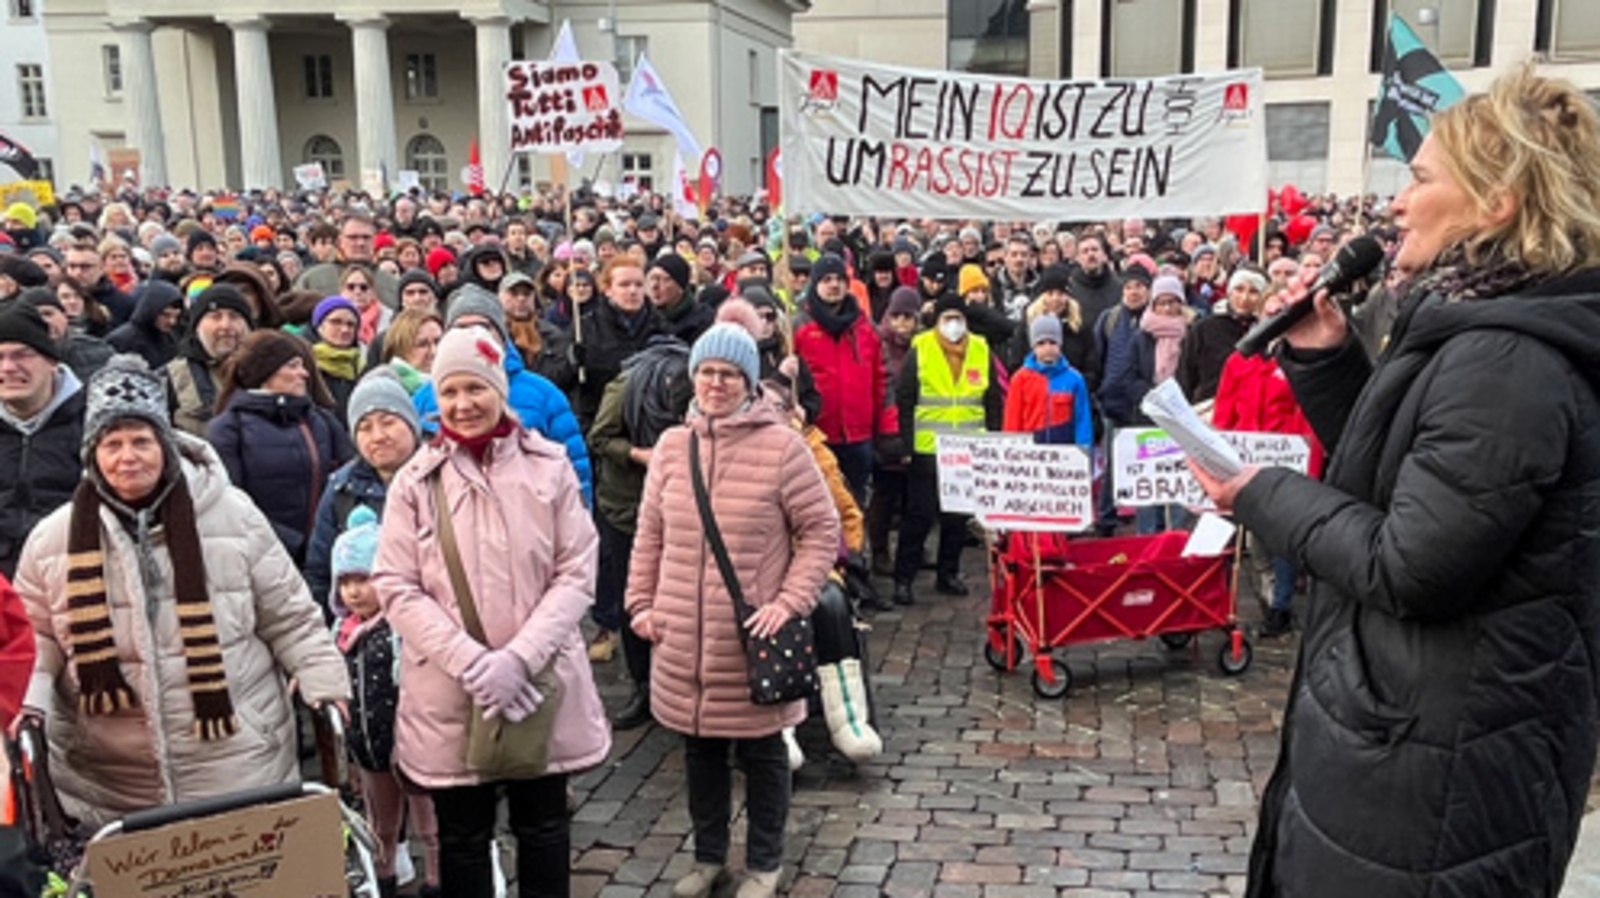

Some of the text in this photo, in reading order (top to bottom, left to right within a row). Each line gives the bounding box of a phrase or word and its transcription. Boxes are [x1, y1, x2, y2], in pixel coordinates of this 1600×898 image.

[508, 63, 598, 91] Siamo
[507, 88, 577, 118] Tutti
[859, 75, 980, 142] MEIN
[988, 82, 1035, 142] IQ
[1034, 83, 1096, 141] IST
[1089, 81, 1154, 139] ZU
[826, 136, 1174, 199] UM RASSIST ZU SEIN
